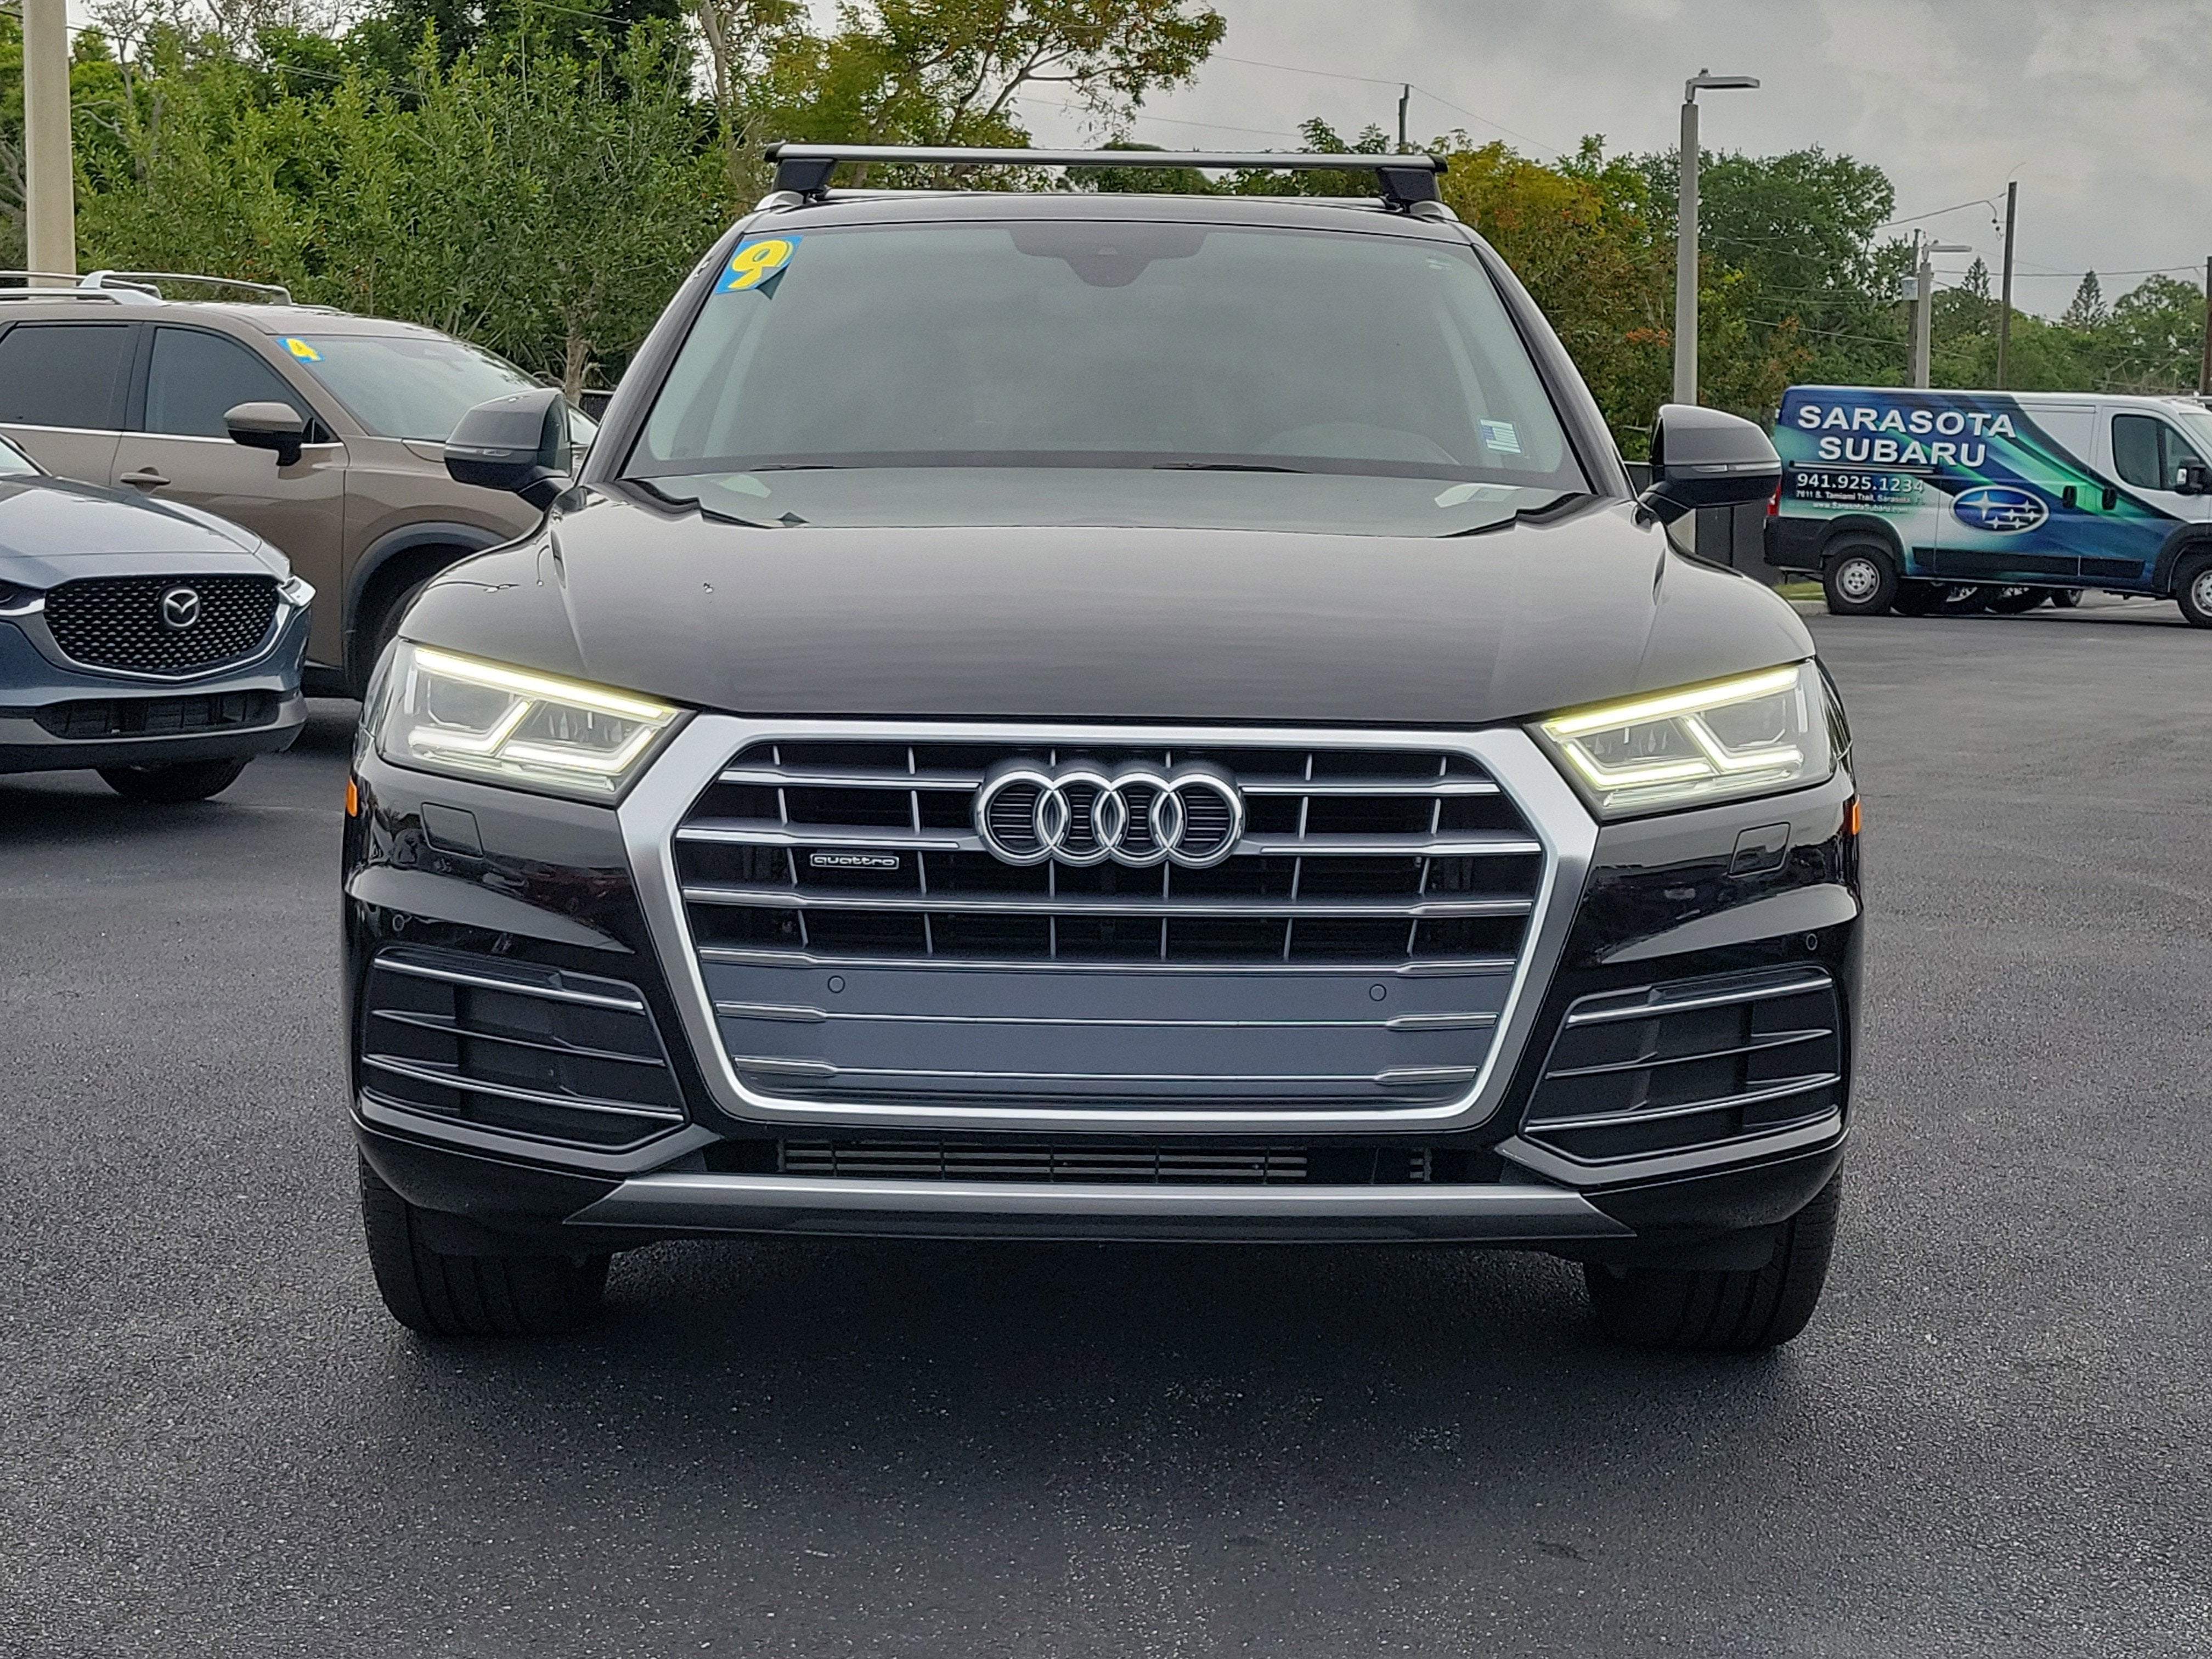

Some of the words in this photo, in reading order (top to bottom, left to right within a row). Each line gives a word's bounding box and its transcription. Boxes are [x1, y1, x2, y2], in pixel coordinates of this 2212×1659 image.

[729, 239, 793, 290] 9
[285, 337, 322, 362] 4
[1798, 405, 2016, 438] SARASOTA
[1818, 437, 1985, 467] SUBARU
[1797, 473, 1924, 494] 941.925.1234
[814, 856, 895, 866] quattro
